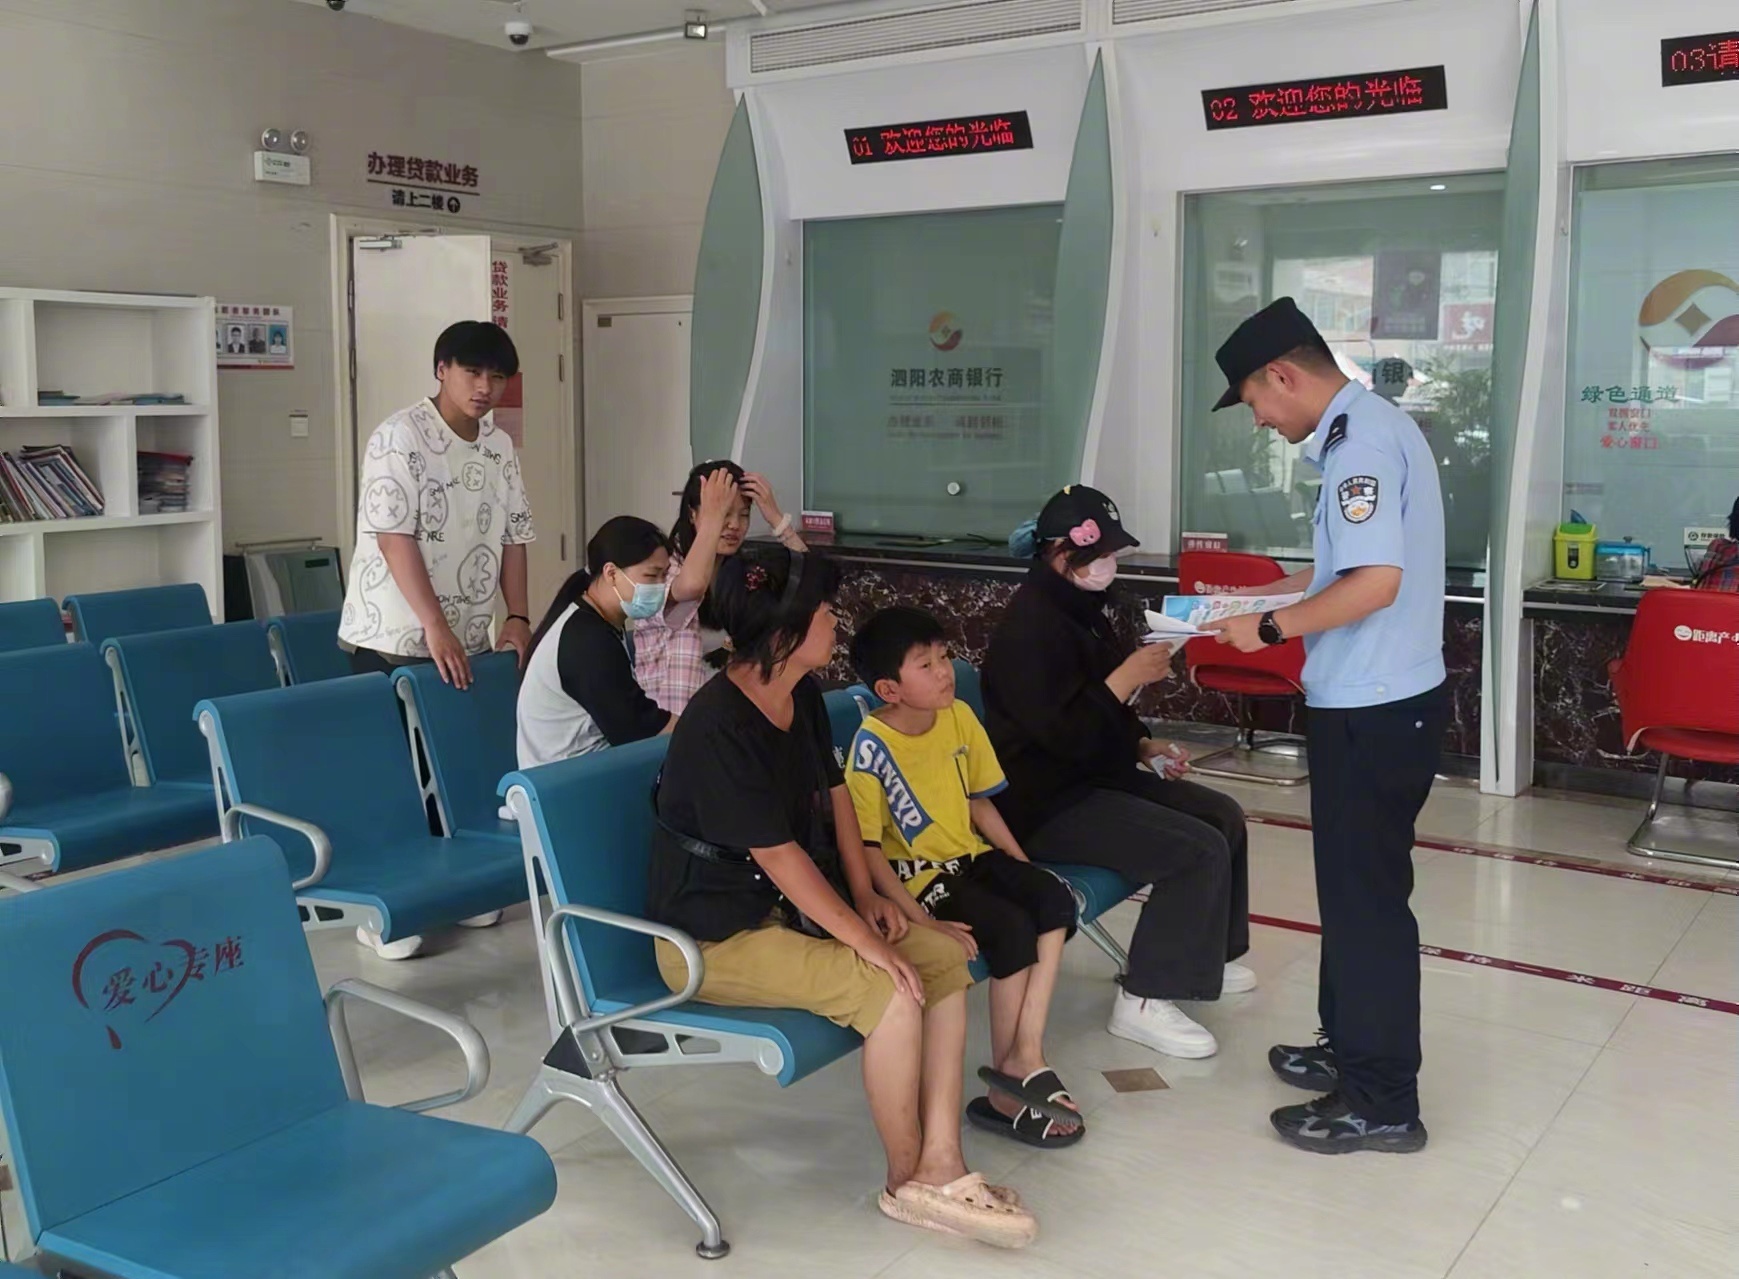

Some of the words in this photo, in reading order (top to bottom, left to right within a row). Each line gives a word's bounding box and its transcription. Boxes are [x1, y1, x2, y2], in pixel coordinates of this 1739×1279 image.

[1210, 97, 1238, 121] 02
[1249, 75, 1423, 120] 欢迎您的光临
[853, 136, 873, 157] 01
[880, 119, 1014, 156] 欢迎您的光临
[367, 151, 479, 188] 办理贷款业务
[392, 189, 444, 211] 请上二楼
[890, 367, 1004, 388] 泗阳农商银行
[1581, 385, 1680, 404] 绿色通道
[102, 935, 245, 1013] 爱心专座
